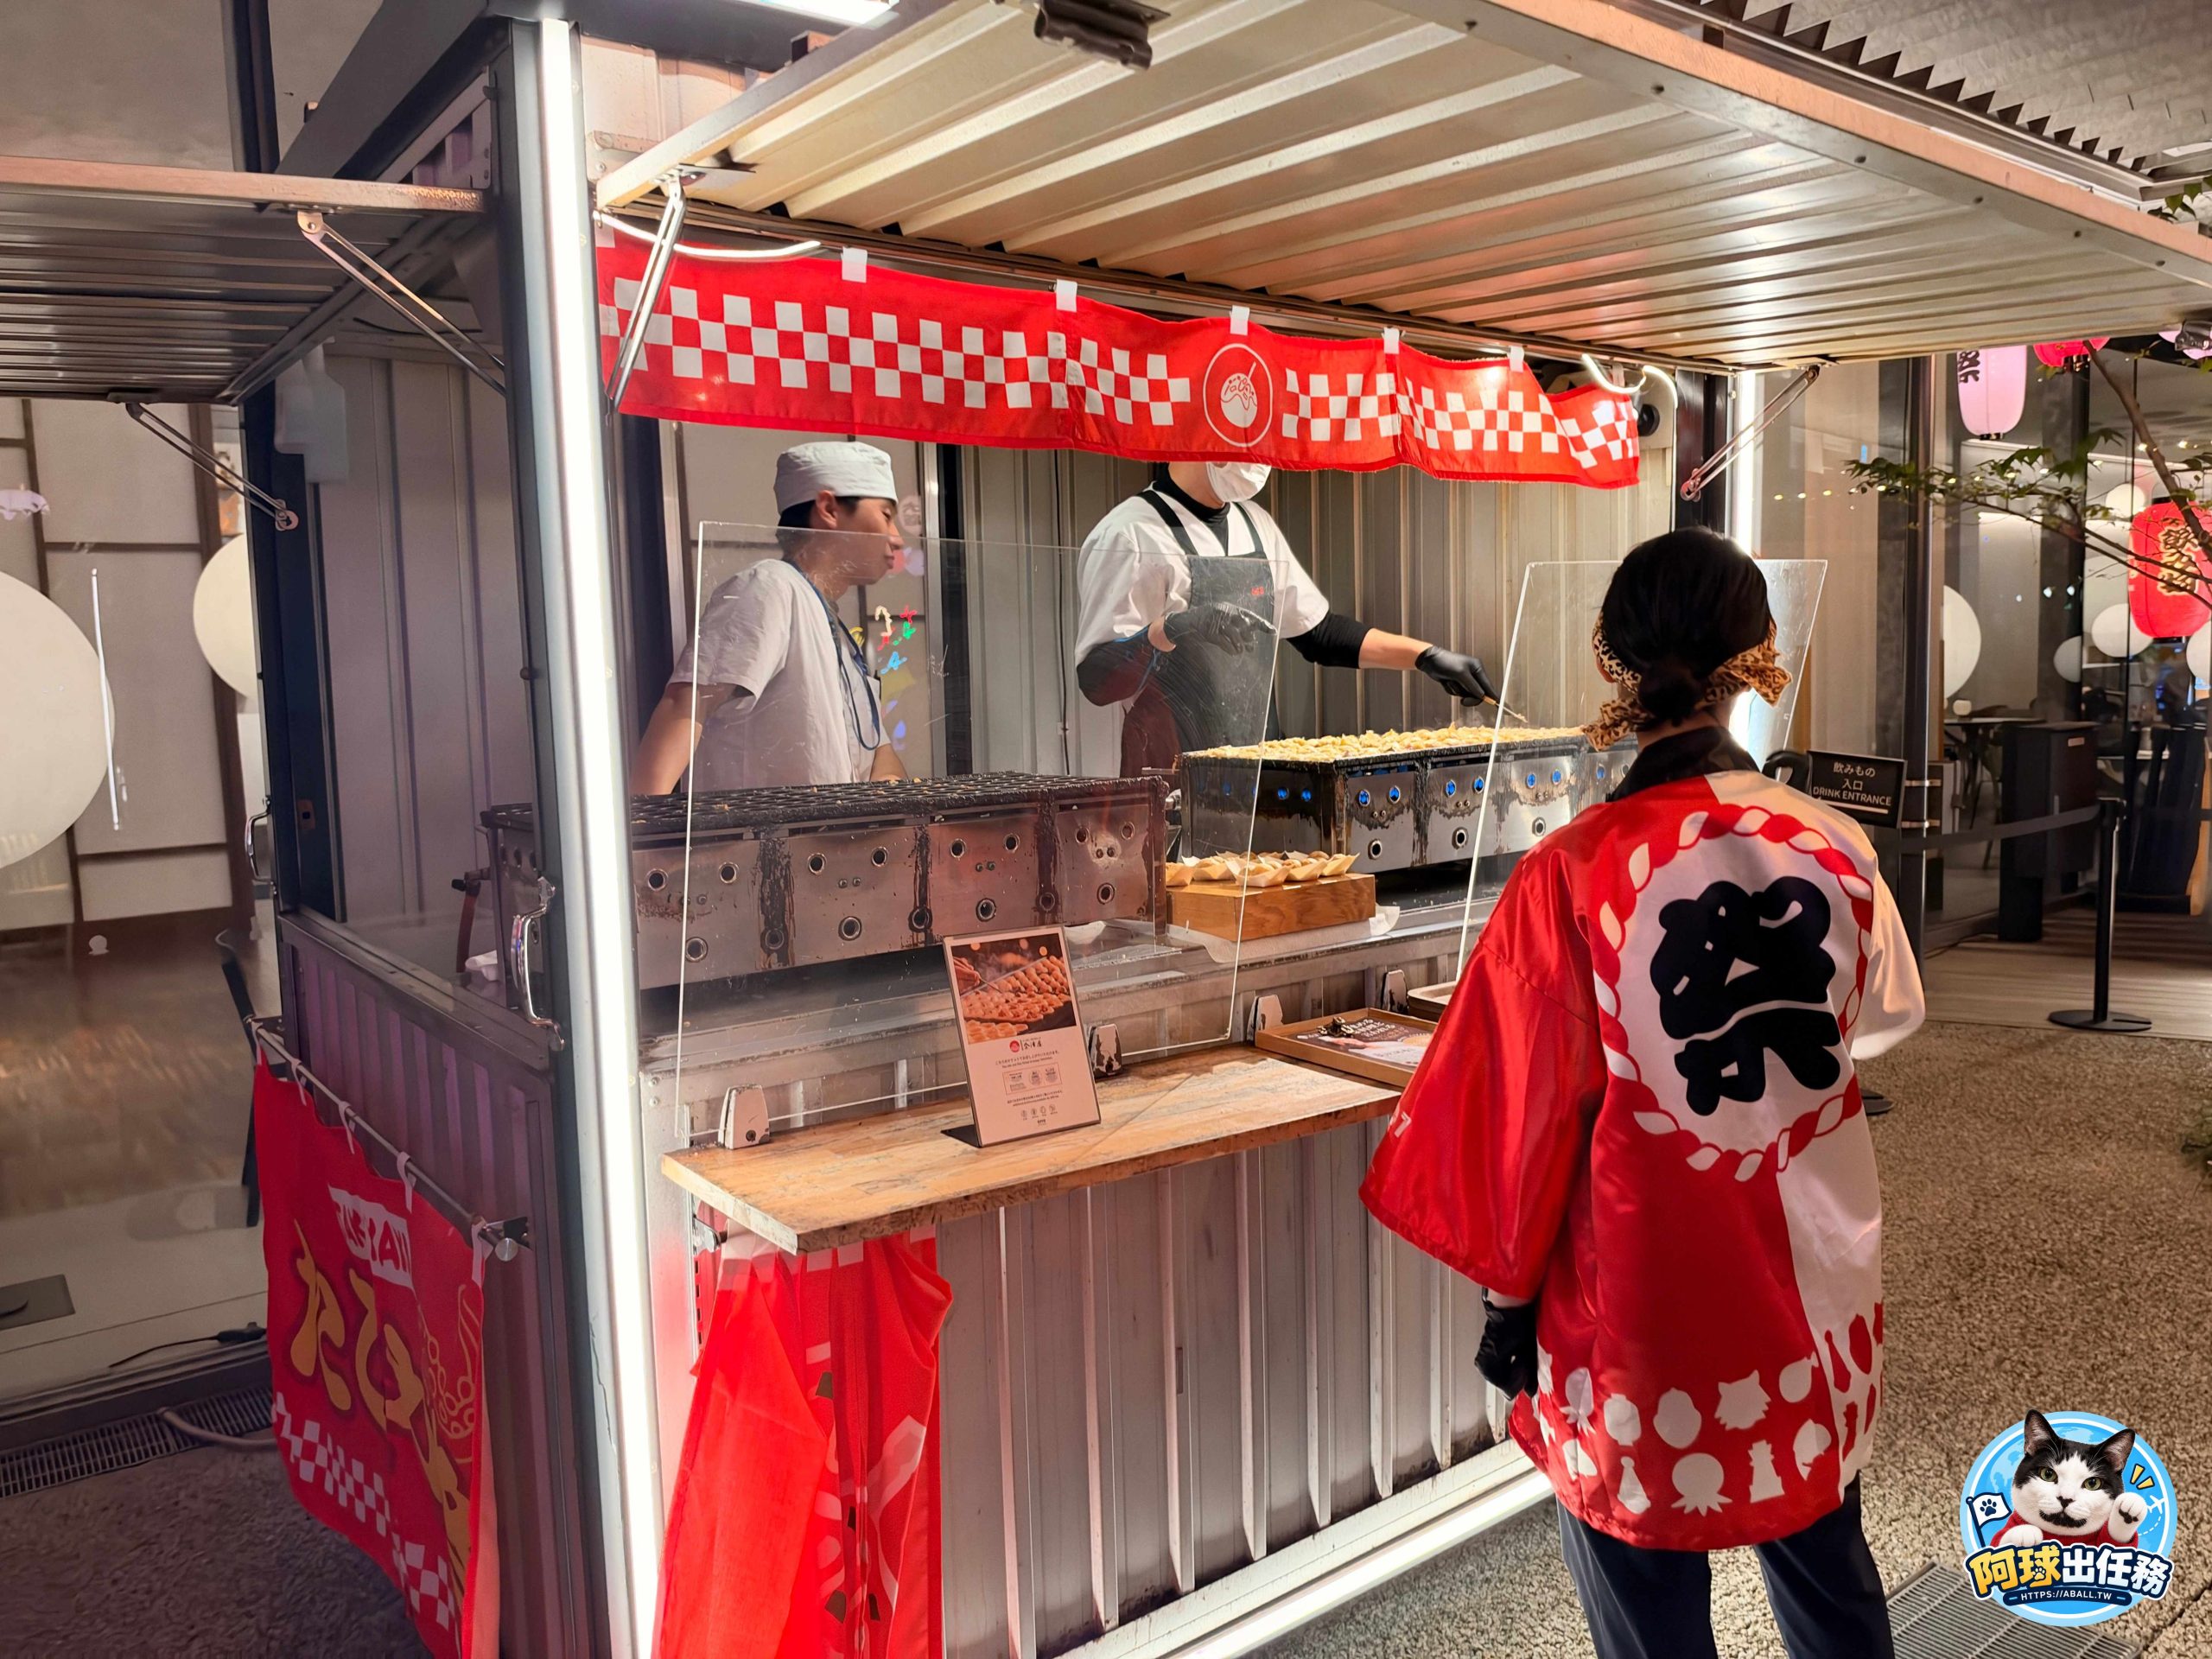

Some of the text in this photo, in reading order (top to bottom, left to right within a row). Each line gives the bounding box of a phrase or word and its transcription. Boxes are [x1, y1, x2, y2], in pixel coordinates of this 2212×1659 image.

[1833, 762, 1876, 778] 飲みもの
[1842, 778, 1863, 791] 入口
[1813, 786, 1892, 806] DRINK ENTRANCE
[1650, 875, 1841, 1116] 祭
